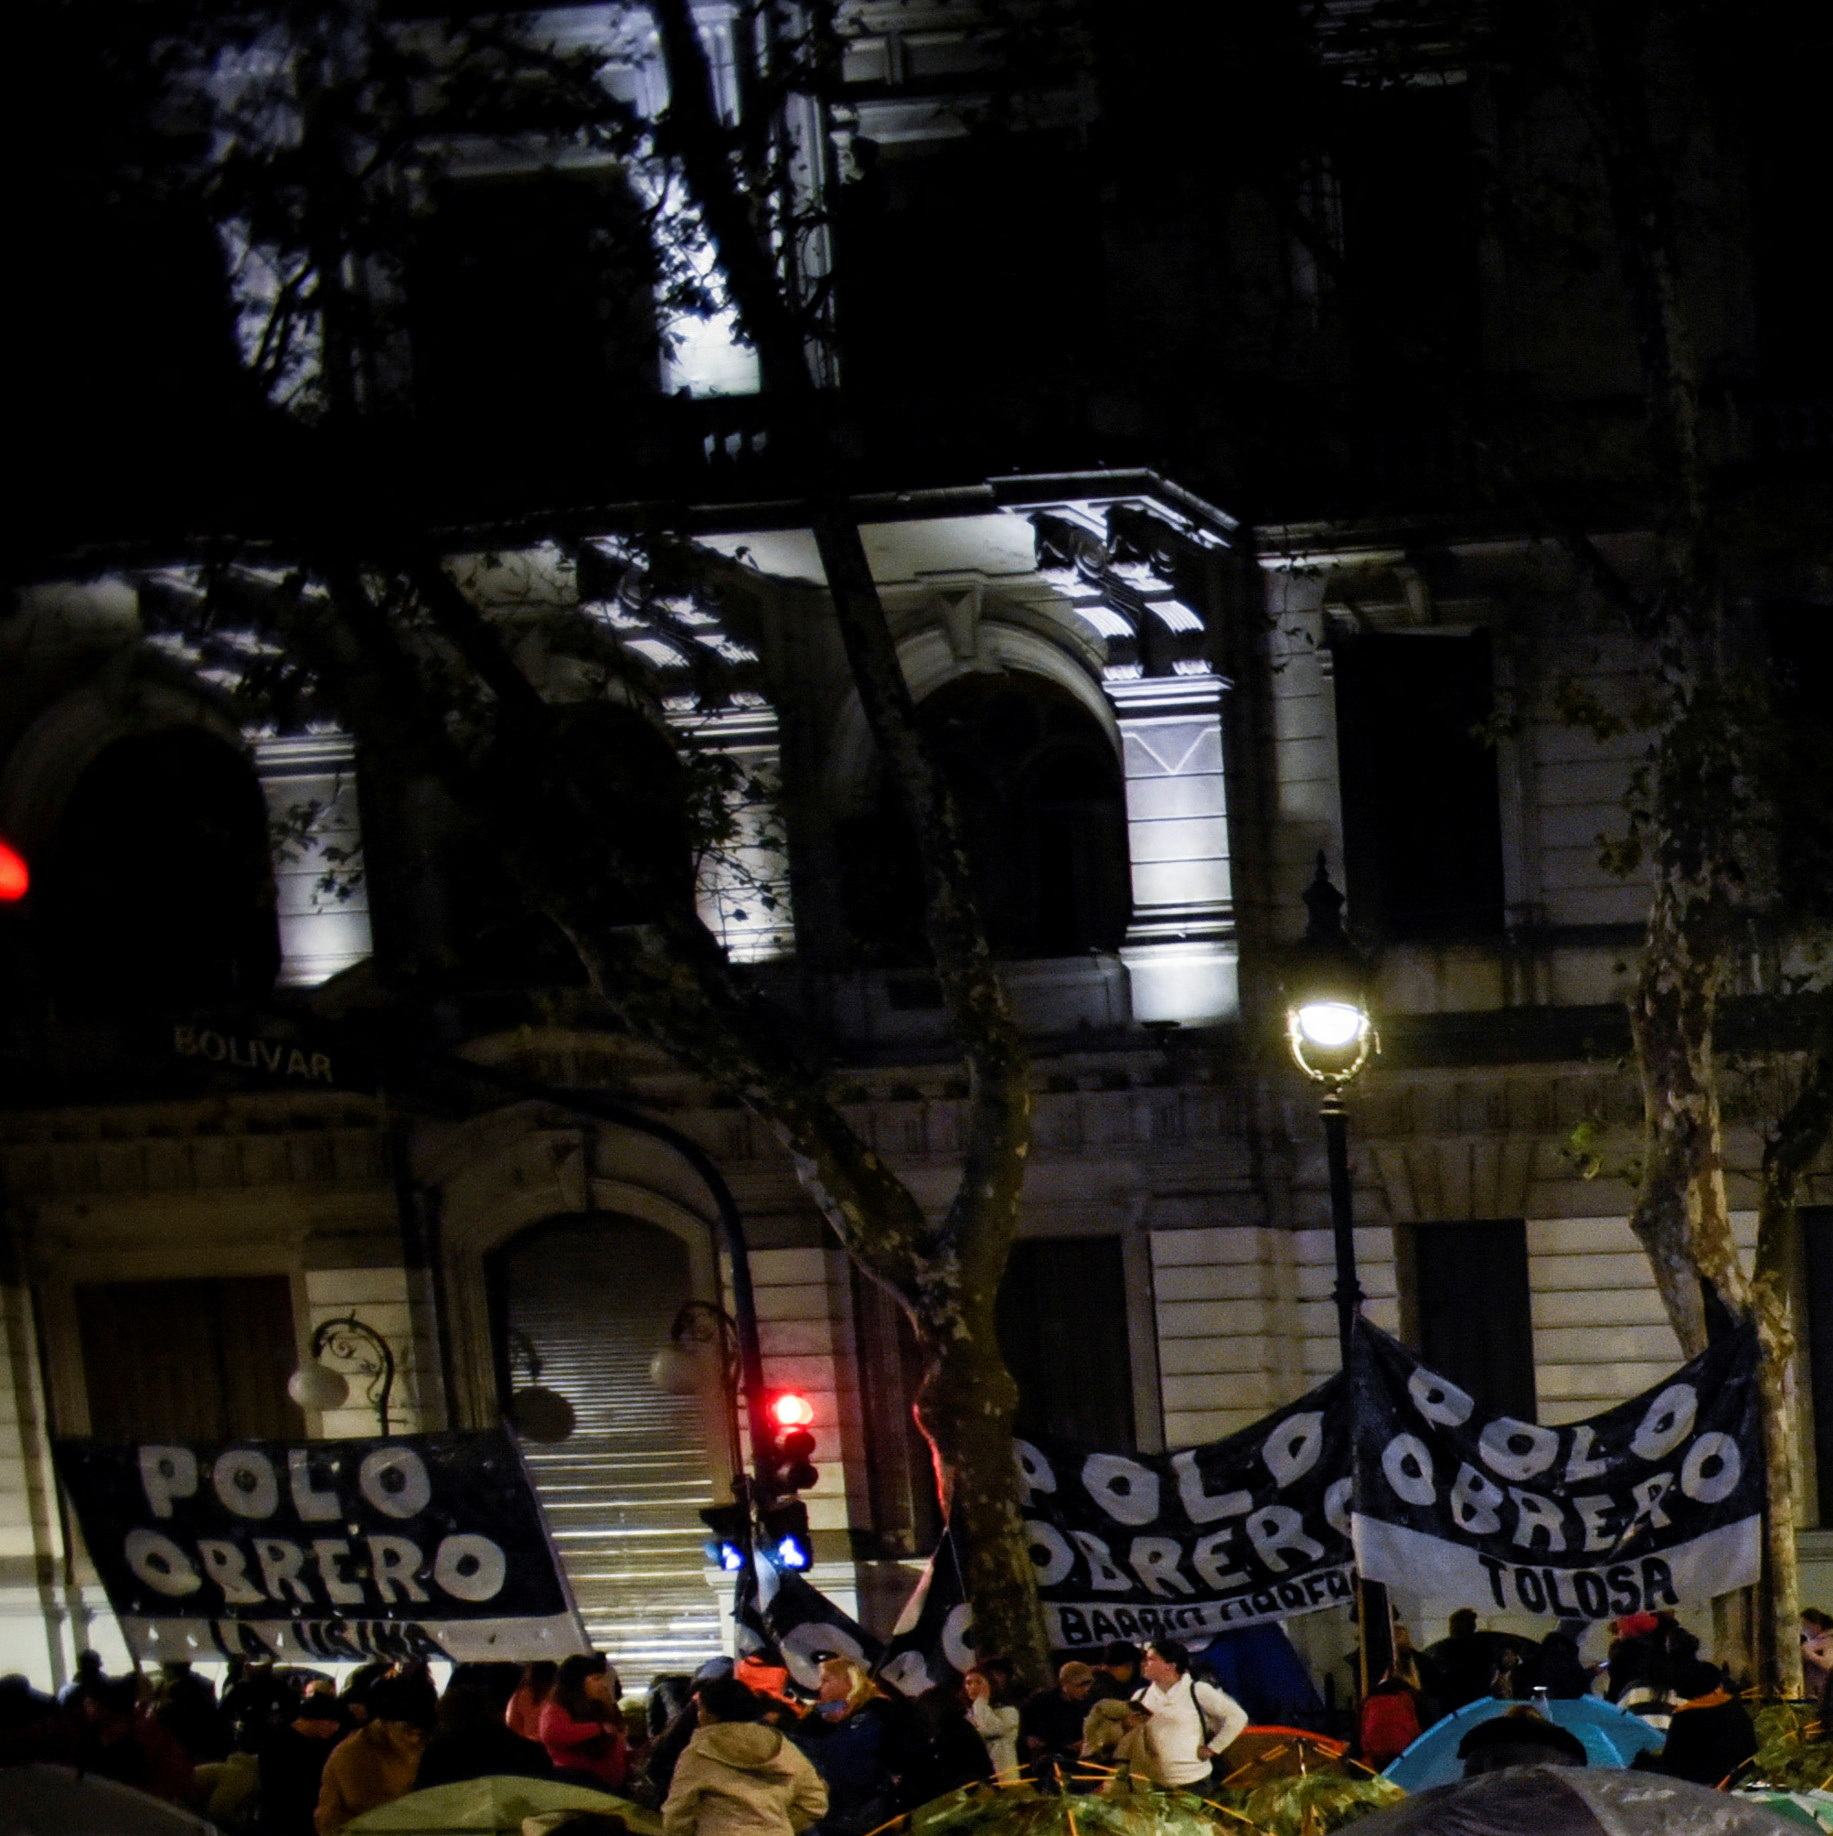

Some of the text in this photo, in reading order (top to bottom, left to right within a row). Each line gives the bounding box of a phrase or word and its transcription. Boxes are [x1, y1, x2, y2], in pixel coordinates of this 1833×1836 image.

[1408, 1367, 1698, 1481] POLO
[139, 1444, 431, 1521] POLO
[1381, 1431, 1742, 1561] OBRERO
[124, 1528, 507, 1605] OBRERO
[1478, 1554, 1678, 1621] TOLOSA
